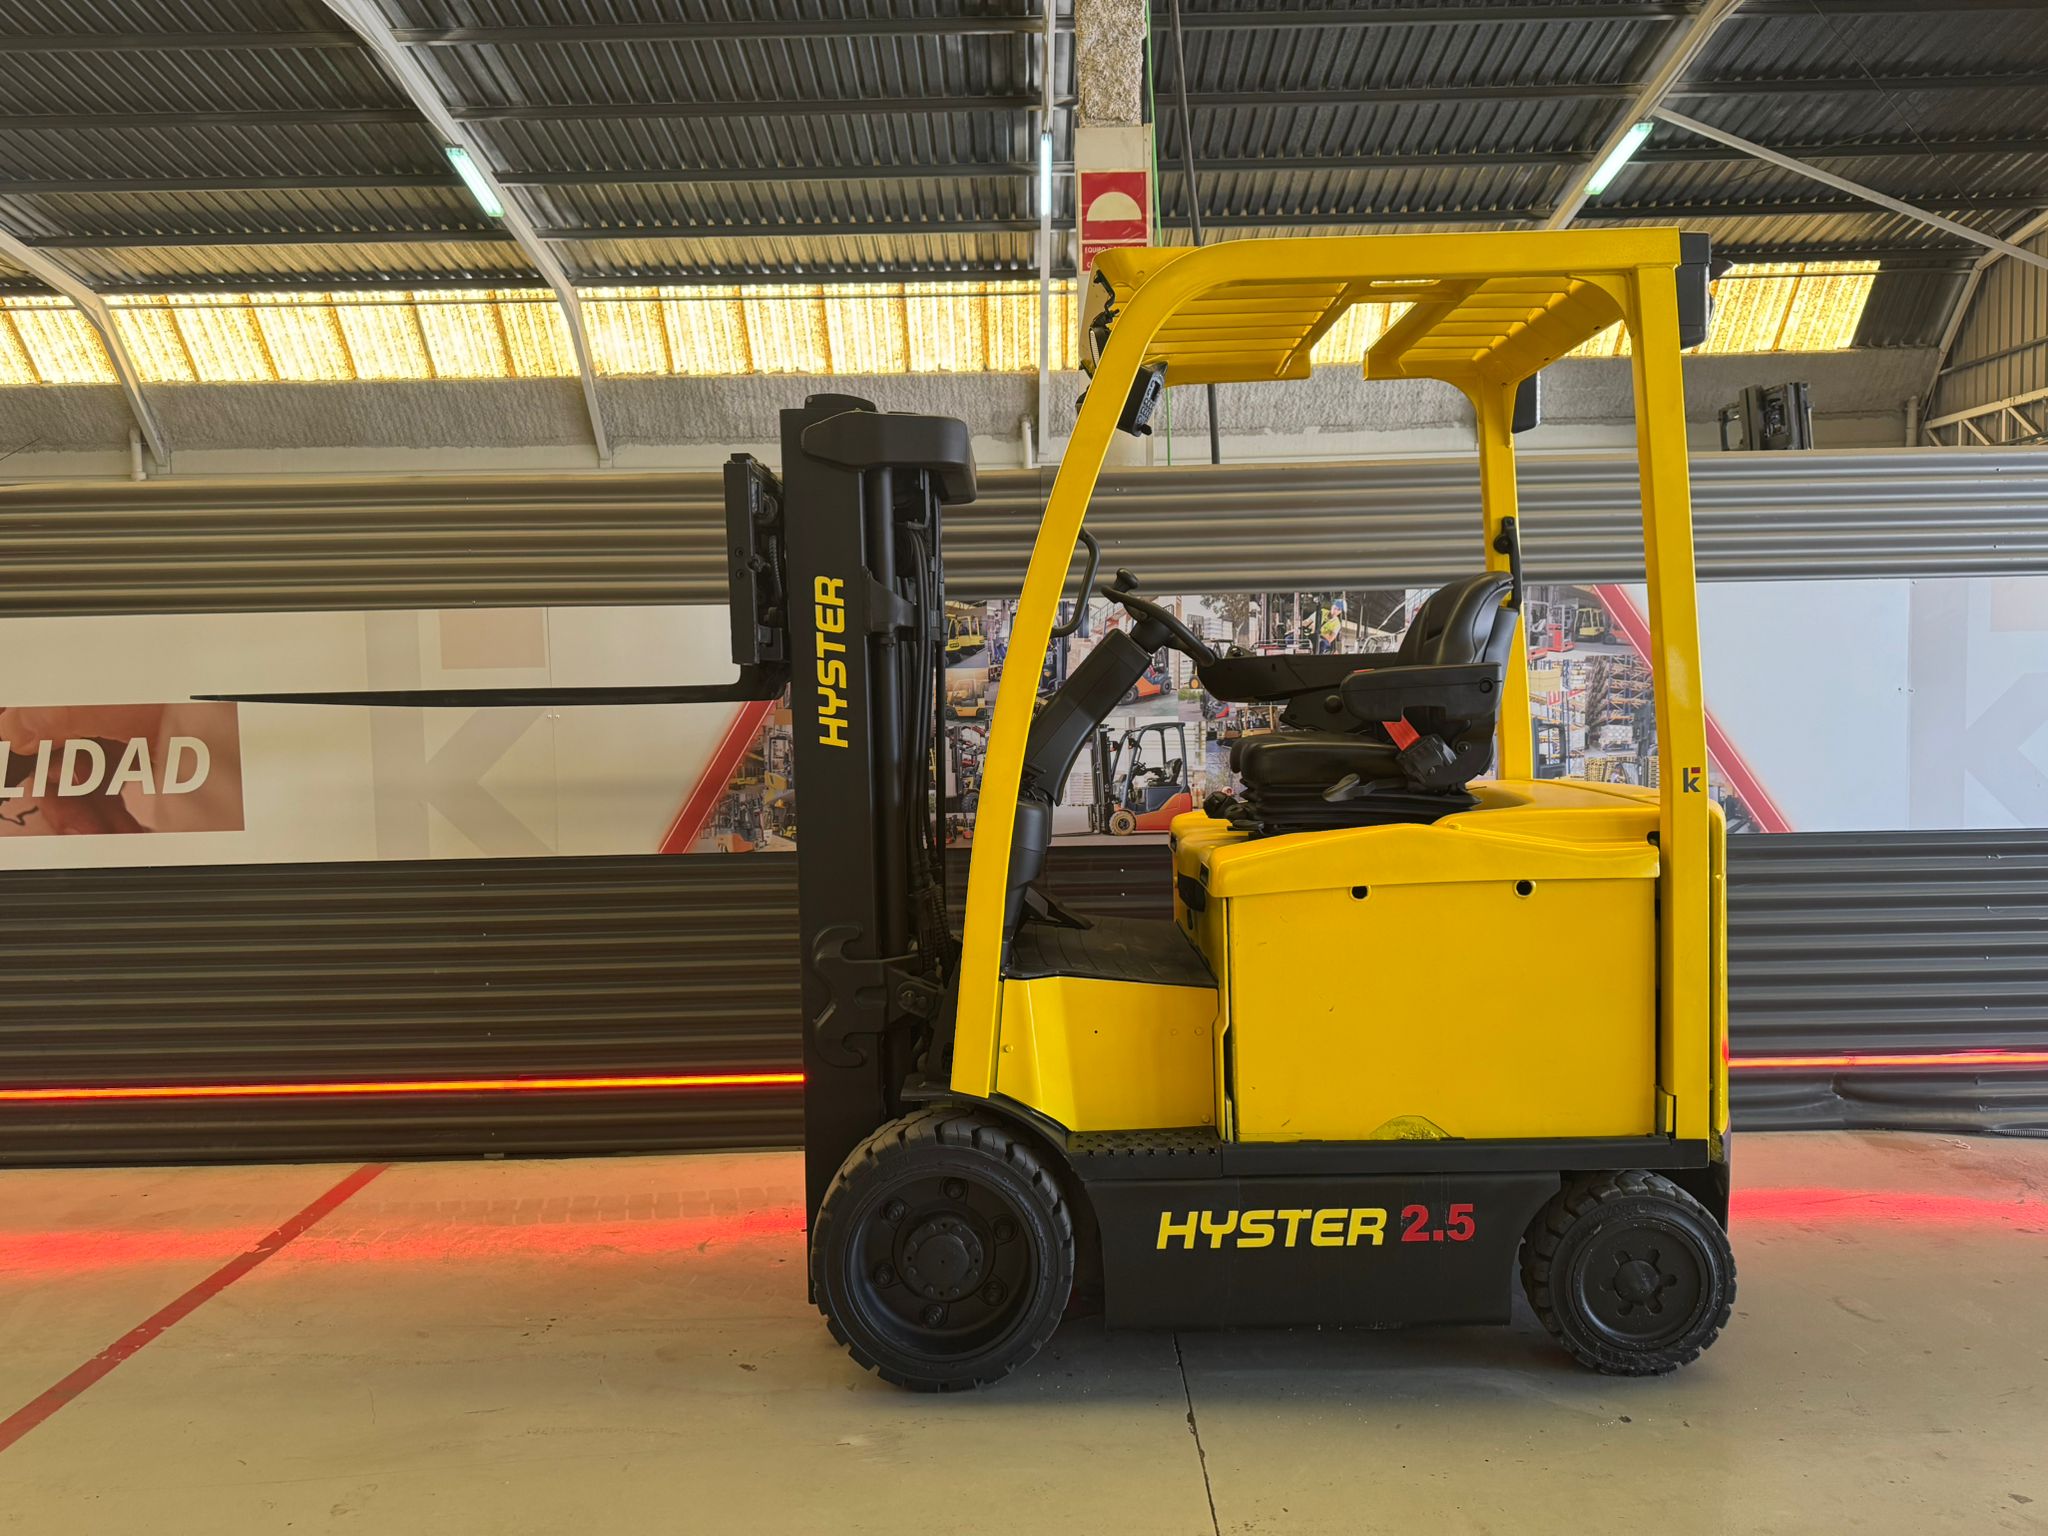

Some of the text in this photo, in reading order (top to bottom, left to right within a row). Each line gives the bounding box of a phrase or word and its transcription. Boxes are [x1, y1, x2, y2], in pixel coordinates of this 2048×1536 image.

[814, 575, 849, 748] HYSTER
[0, 736, 210, 797] LIDAD
[1156, 1203, 1475, 1249] HYSTER 2.5
